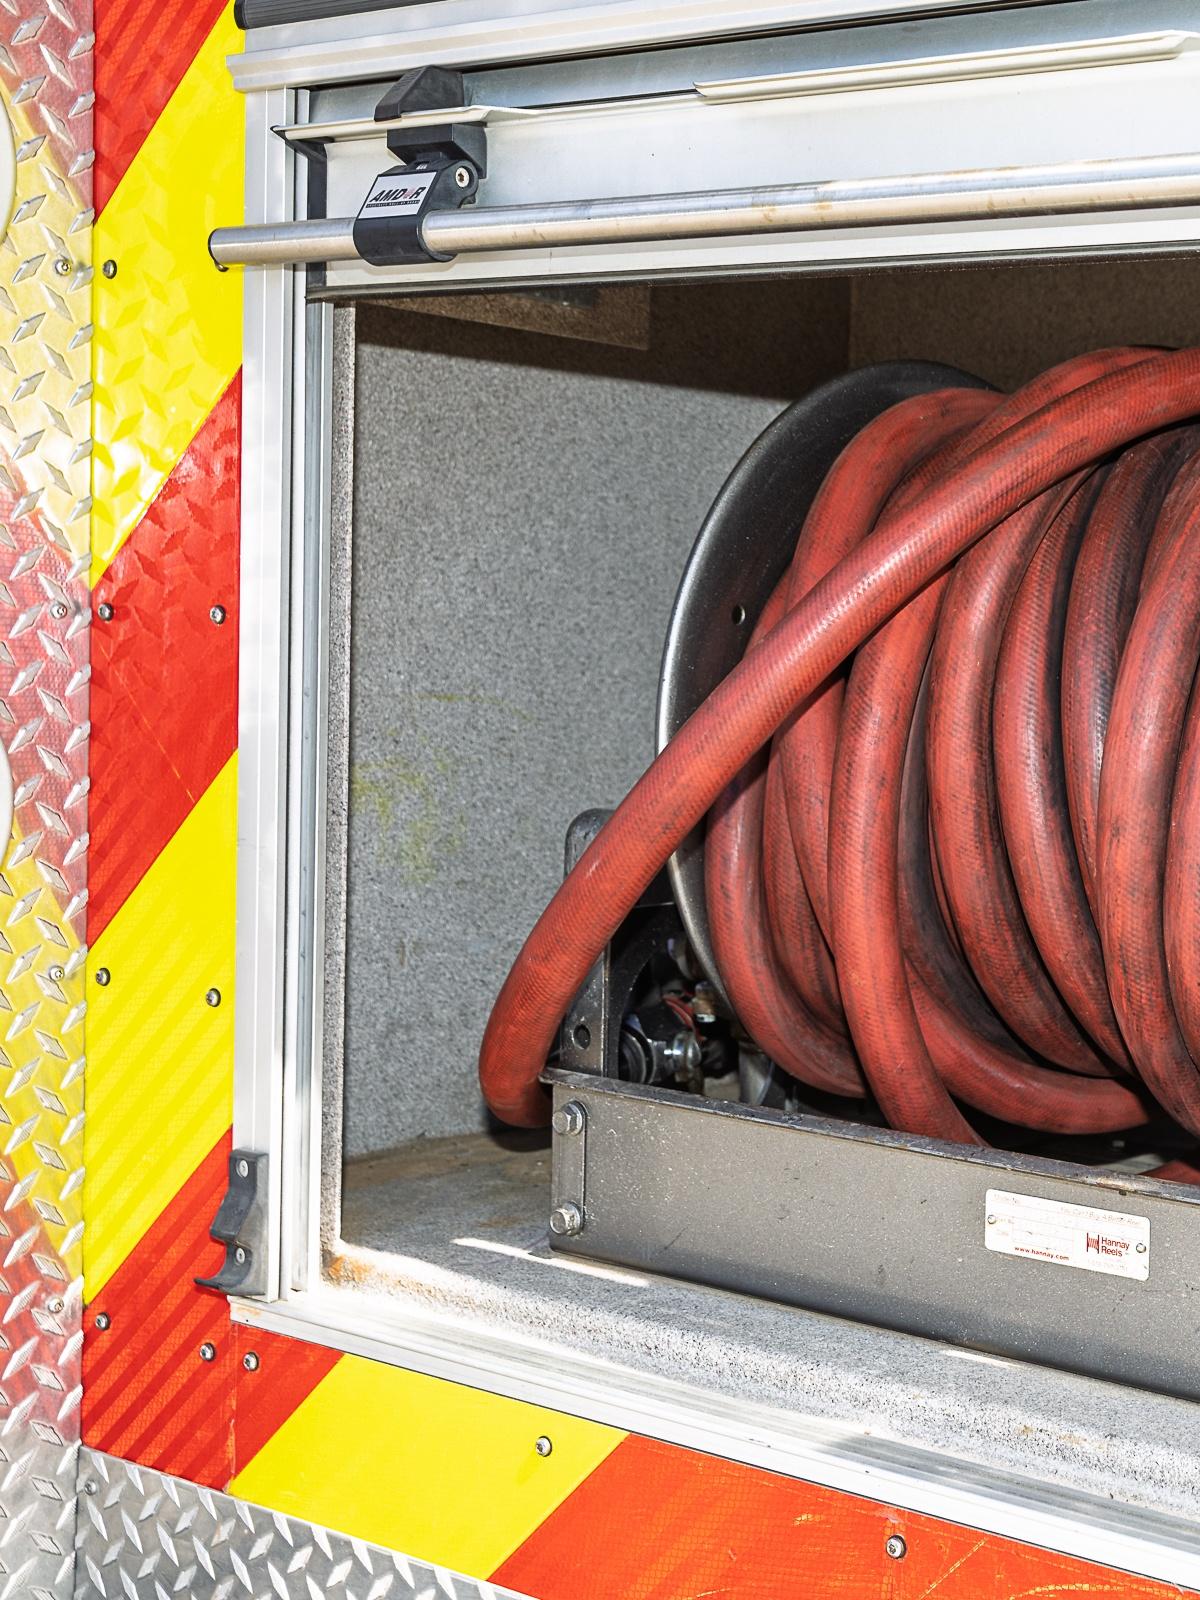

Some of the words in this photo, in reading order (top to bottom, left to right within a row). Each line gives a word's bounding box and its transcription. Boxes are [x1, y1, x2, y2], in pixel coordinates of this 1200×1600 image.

[1101, 1236, 1130, 1251] Hannay
[1014, 1246, 1070, 1261] www.hannay.com
[1101, 1245, 1123, 1258] Reels
